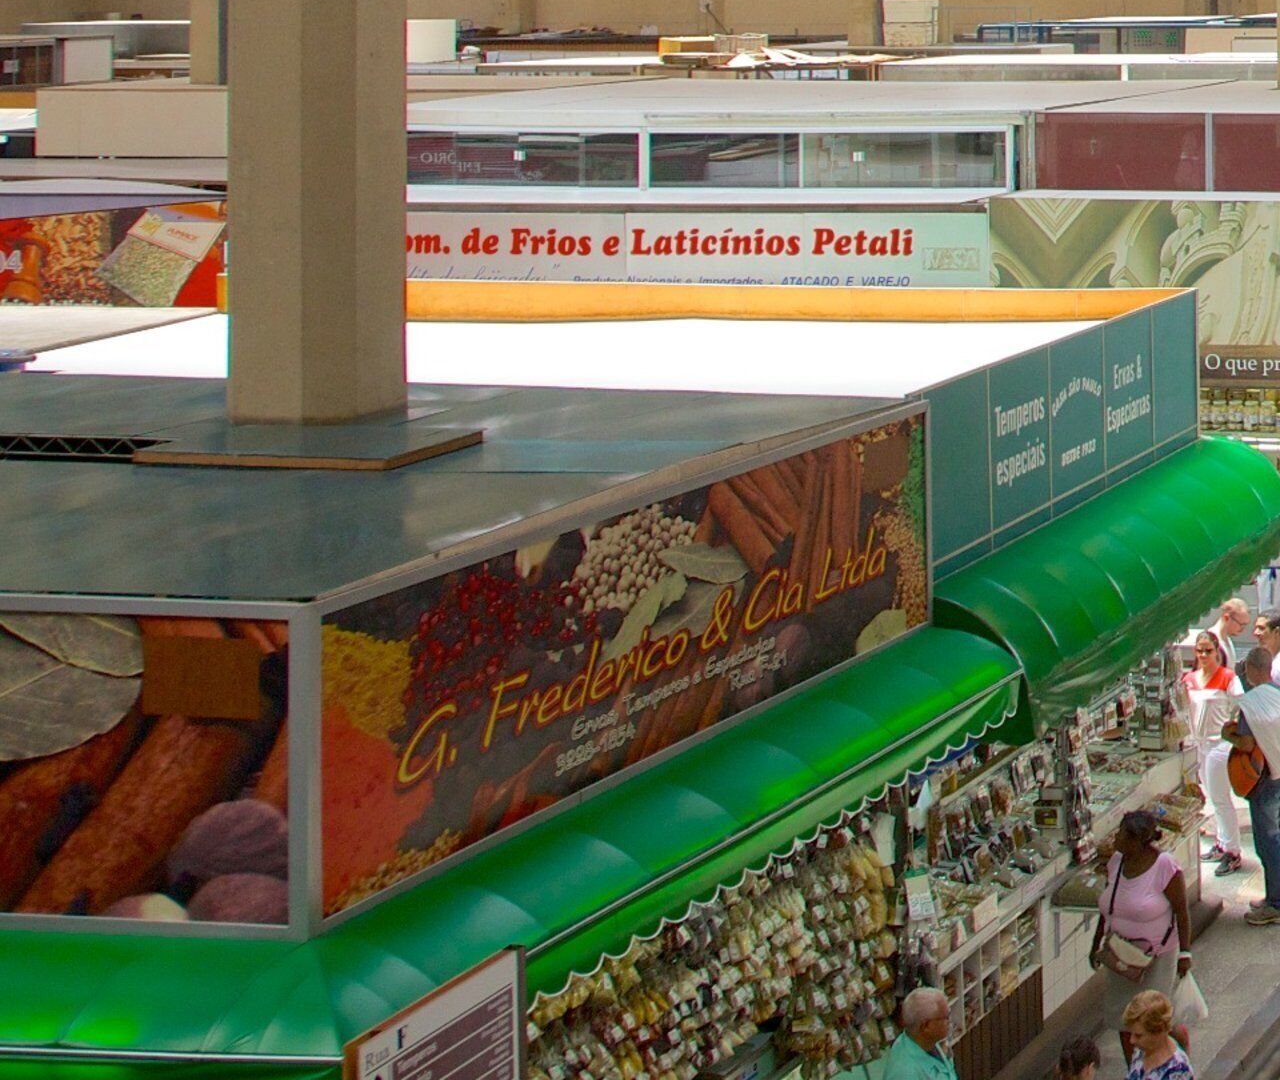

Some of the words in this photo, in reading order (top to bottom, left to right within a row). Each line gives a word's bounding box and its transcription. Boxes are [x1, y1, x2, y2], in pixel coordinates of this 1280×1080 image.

[461, 228, 499, 255] de
[510, 228, 592, 255] Frios
[602, 235, 620, 256] e
[630, 227, 801, 256] Laticínios
[811, 228, 914, 256] Petali
[781, 276, 840, 286] ATACADO
[845, 277, 855, 287] E
[860, 277, 910, 288] VAREJO
[1113, 363, 1135, 390] Ervas
[1136, 353, 1143, 379] &
[1204, 353, 1221, 370] O
[1225, 357, 1258, 375] que
[995, 395, 1046, 438] Temperos
[1052, 388, 1068, 417] CASA
[1068, 377, 1081, 398] SÃO
[1081, 376, 1102, 397] PAULO
[1106, 394, 1151, 434] Especiarias
[996, 437, 1046, 487] especiais
[1061, 445, 1081, 467] DESDE
[398, 703, 458, 785] G.
[482, 626, 690, 751] Frederico
[700, 585, 735, 651] &
[743, 567, 803, 634] Cia
[815, 527, 887, 601] Ltda
[622, 675, 690, 717] Temperos
[693, 674, 702, 685] e
[705, 636, 776, 680] Especiarias
[729, 668, 757, 692] Rua
[364, 1047, 391, 1072] Rua
[396, 1024, 409, 1050] F
